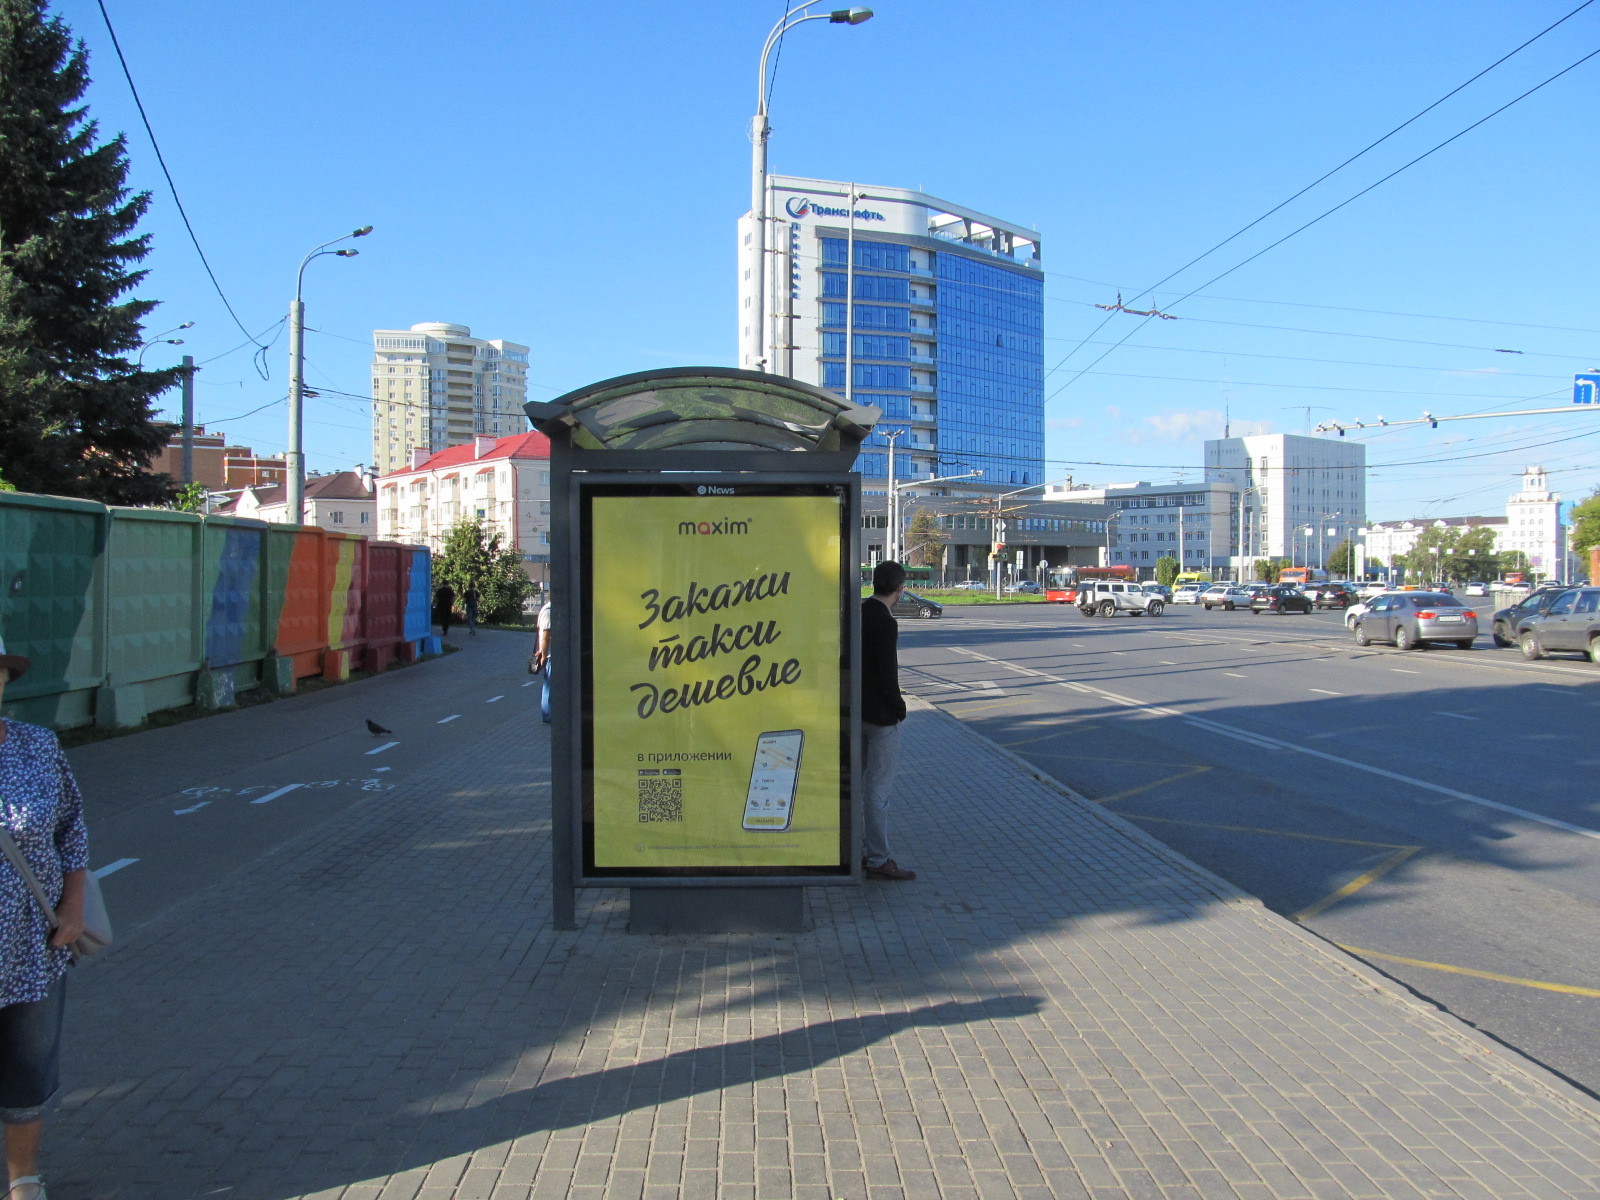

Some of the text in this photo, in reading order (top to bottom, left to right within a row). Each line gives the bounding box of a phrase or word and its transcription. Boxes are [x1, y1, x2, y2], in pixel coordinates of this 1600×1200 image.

[708, 485, 735, 495] News
[638, 571, 791, 629] Закажи
[648, 620, 782, 672] такси
[630, 653, 802, 719] дешевле
[637, 752, 732, 764] в приложении
